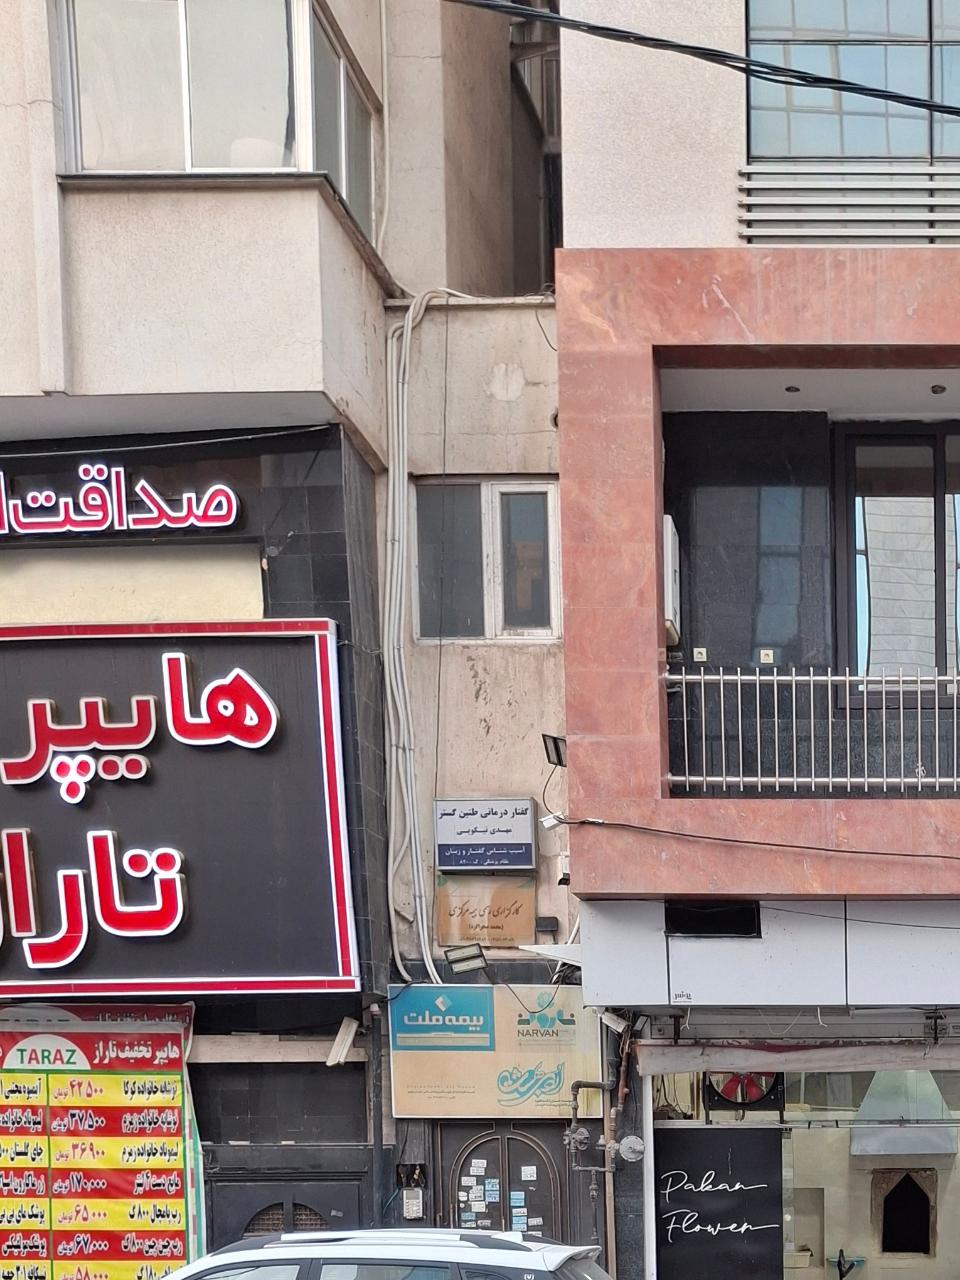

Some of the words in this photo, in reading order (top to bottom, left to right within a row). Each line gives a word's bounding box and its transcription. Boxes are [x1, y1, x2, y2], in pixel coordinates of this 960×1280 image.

[9, 464, 239, 534] صداقت
[0, 652, 278, 804] هایپر
[438, 808, 457, 820] گستر
[480, 807, 508, 819] درمانی
[511, 807, 529, 819] گفتار
[0, 827, 185, 970] تارا
[492, 900, 524, 919] کارگزاری
[403, 1010, 443, 1026] ملت
[445, 1015, 484, 1032] بیمه
[517, 1029, 559, 1038] NARVAN
[16, 1048, 77, 1065] TARAZ
[93, 1039, 118, 1064] تاراز
[118, 1039, 152, 1063] تخفیف
[154, 1040, 180, 1064] هایپر
[659, 1170, 769, 1204] Pakan
[662, 1209, 781, 1243] Flower
